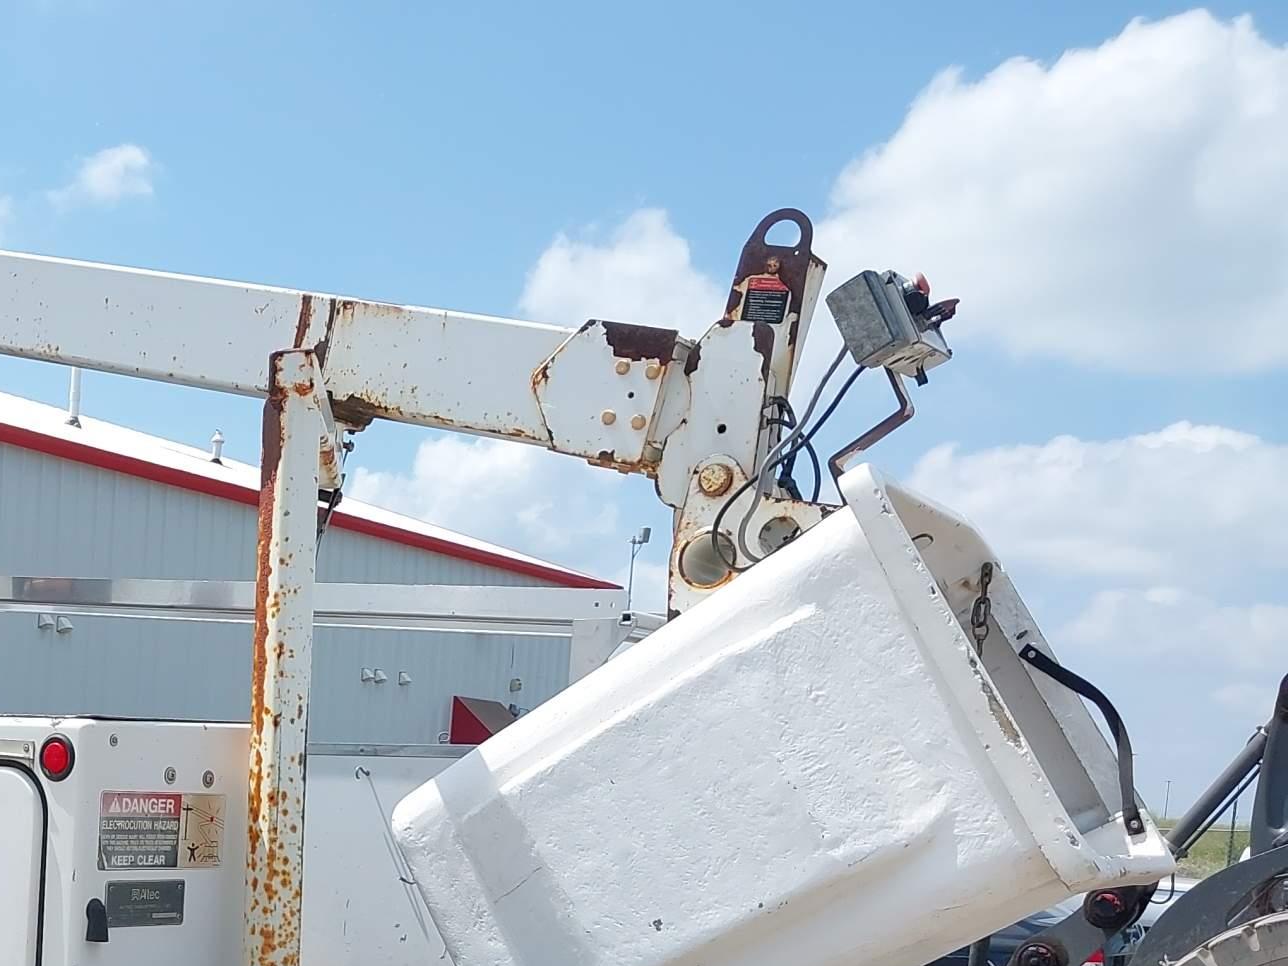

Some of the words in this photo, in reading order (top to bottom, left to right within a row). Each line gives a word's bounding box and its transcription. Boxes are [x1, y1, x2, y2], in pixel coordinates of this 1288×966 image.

[122, 798, 175, 814] DANGER
[102, 820, 152, 831] ELECTROCUTION
[153, 820, 179, 831] HAZARD
[111, 855, 134, 866] KEEP
[137, 855, 166, 866] CLEAR
